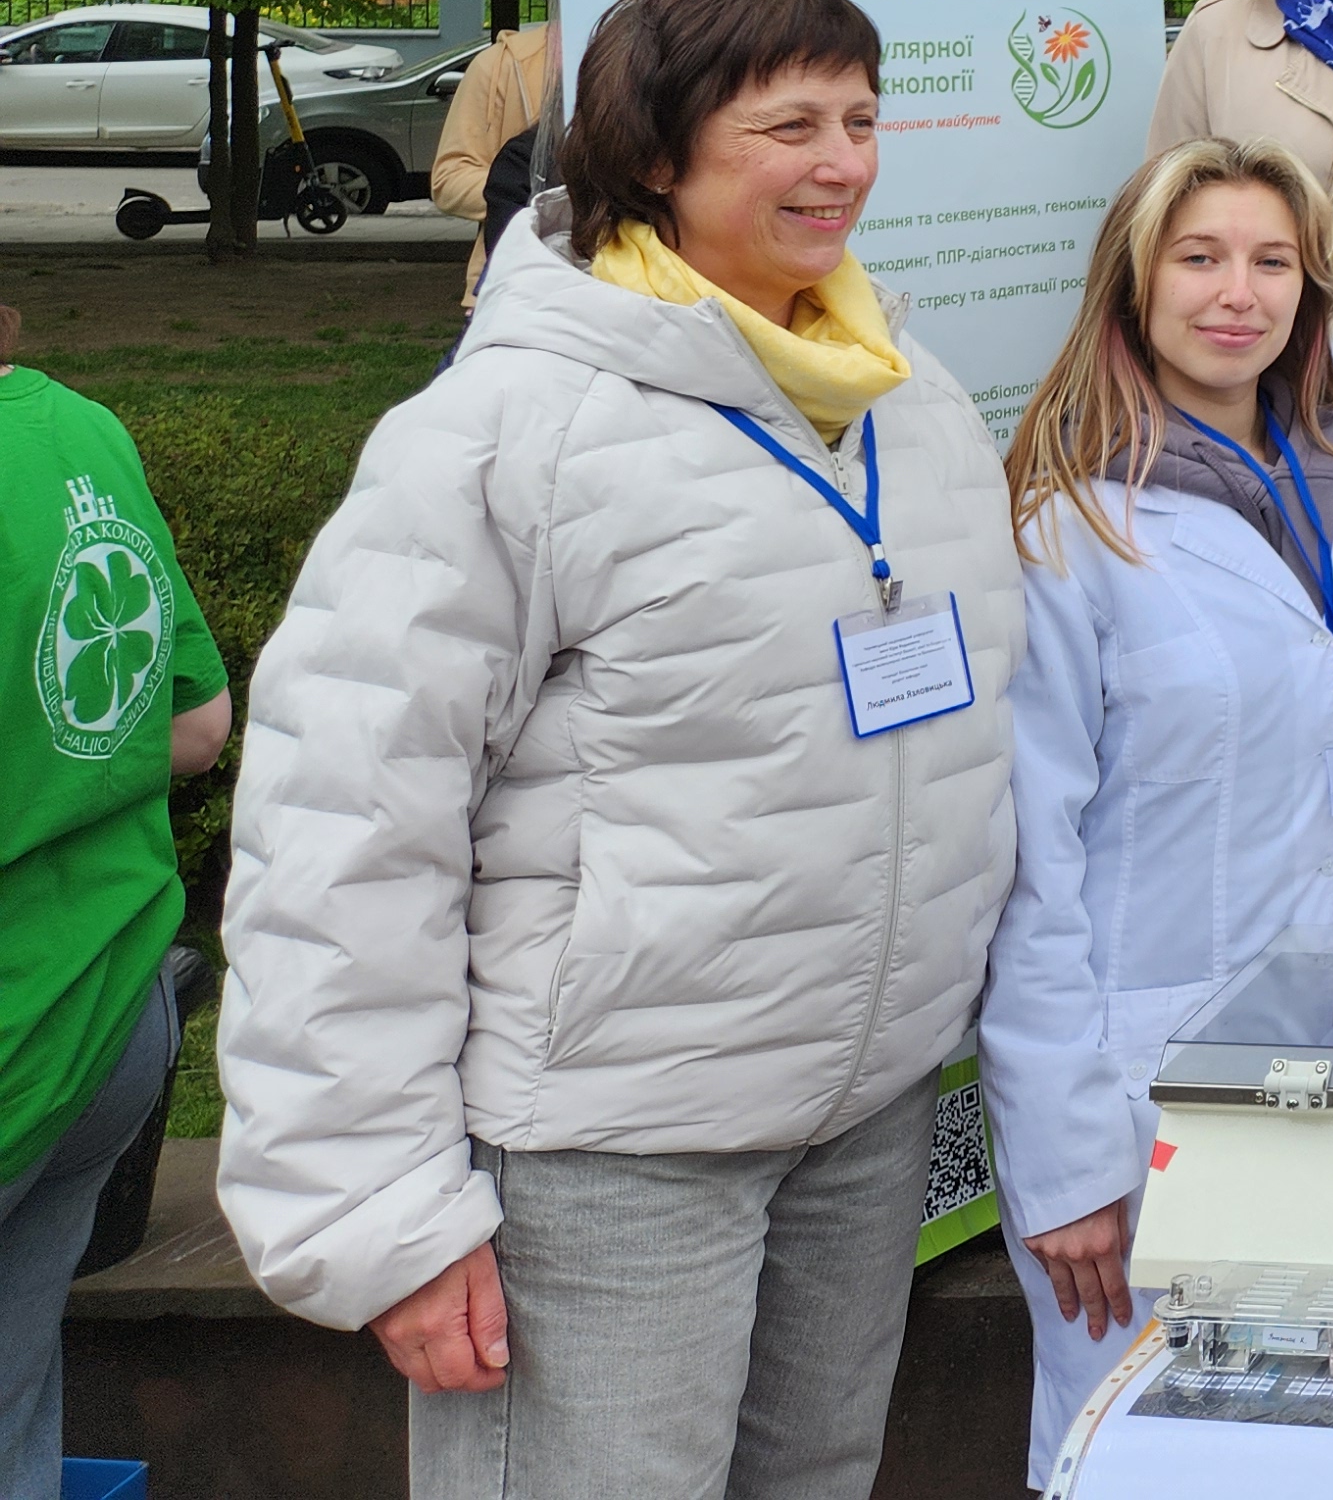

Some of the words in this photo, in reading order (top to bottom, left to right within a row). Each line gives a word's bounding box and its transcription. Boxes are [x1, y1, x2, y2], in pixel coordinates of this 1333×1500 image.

[880, 35, 974, 66] улярної
[879, 69, 975, 95] хнології
[936, 113, 1002, 131] майбутнє
[855, 216, 912, 236] ування
[917, 214, 932, 226] та
[937, 202, 1041, 223] секвенування,
[1044, 196, 1107, 213] геноміка
[936, 241, 1056, 266] ПЛР-діагностика
[1060, 238, 1076, 250] та
[918, 291, 966, 310] стресу
[970, 289, 985, 301] та
[989, 278, 1057, 300] адаптації
[1060, 276, 1087, 292] рос
[970, 379, 1039, 404] робіологі
[994, 428, 1009, 440] та
[867, 692, 905, 711] Людмила
[906, 679, 953, 700] Язловицька
